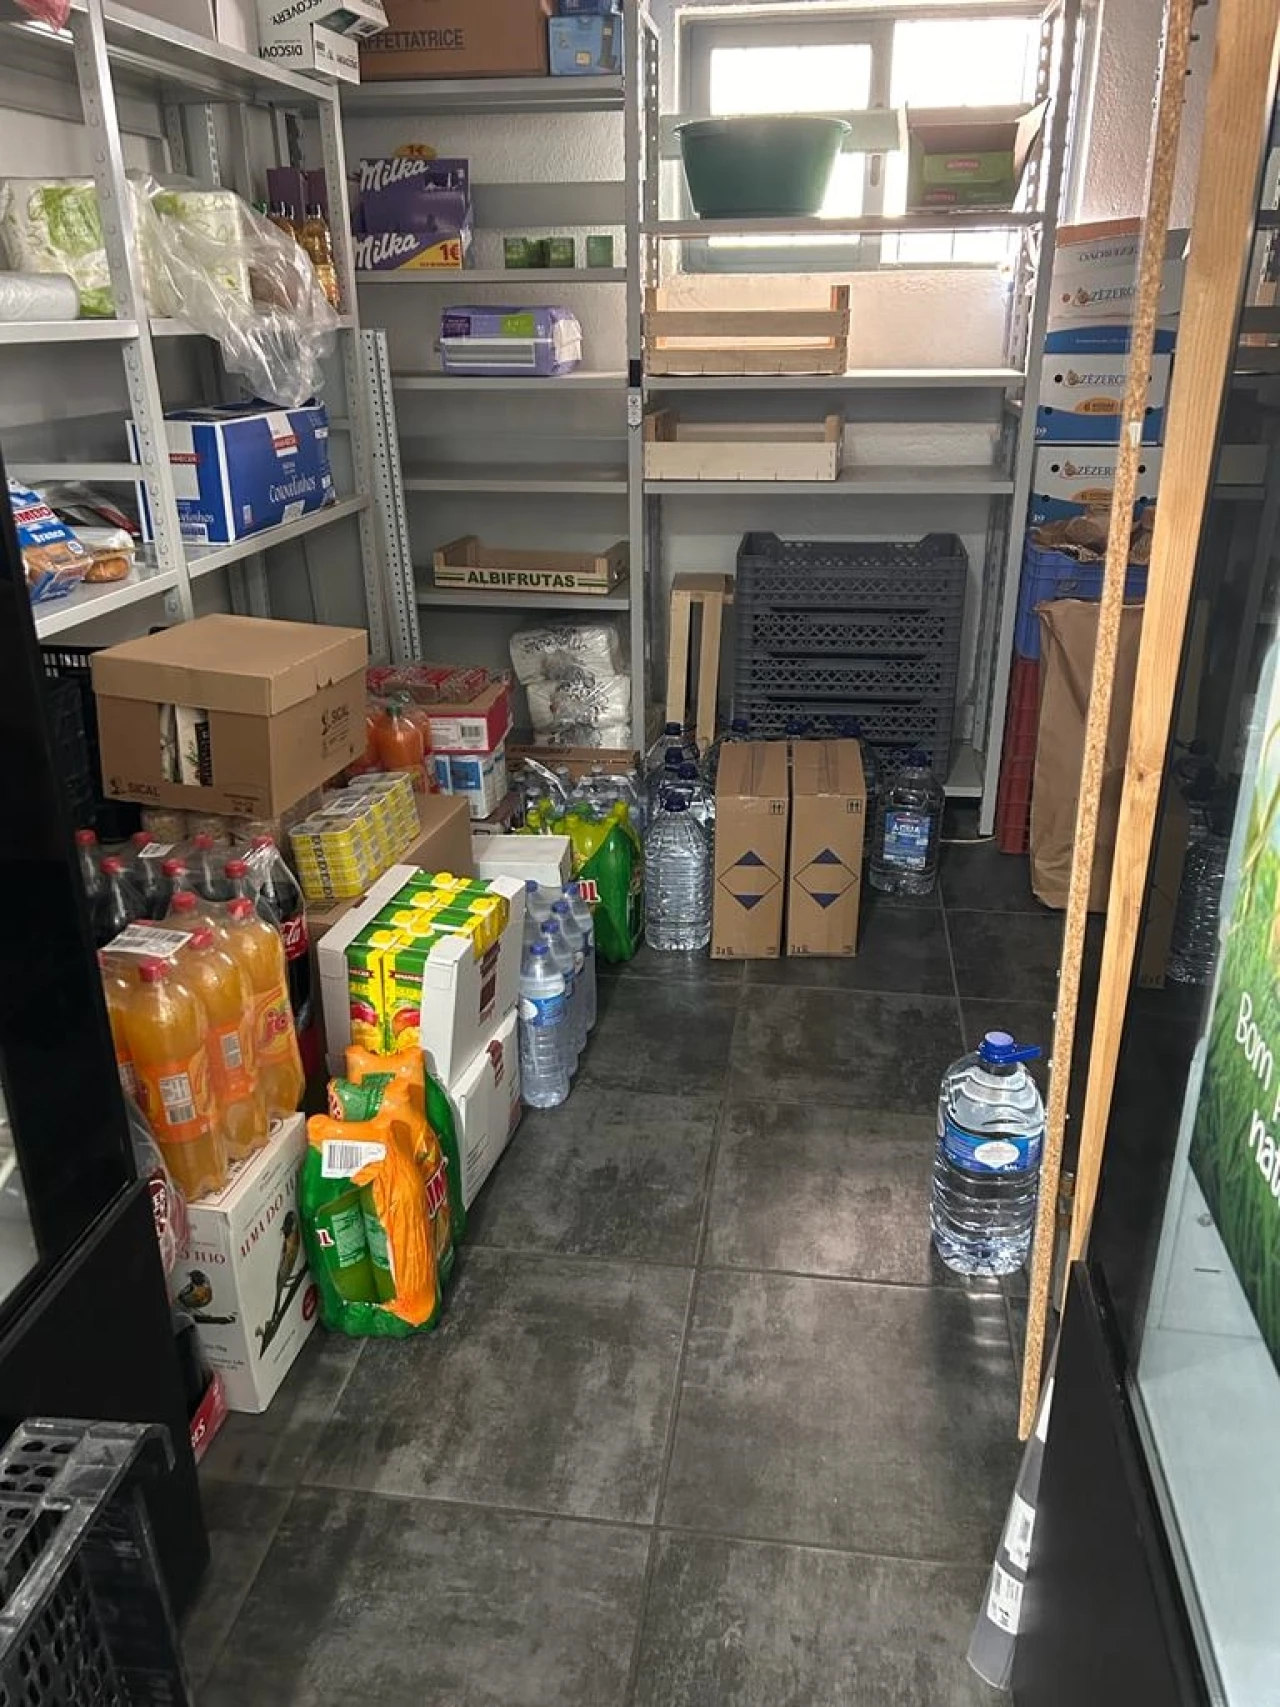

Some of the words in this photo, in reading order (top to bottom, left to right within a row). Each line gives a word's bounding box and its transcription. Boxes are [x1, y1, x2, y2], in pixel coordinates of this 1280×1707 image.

[360, 158, 429, 192] Milka
[351, 233, 420, 270] Milka
[440, 244, 460, 261] 1€
[16, 507, 52, 523] IMBO
[467, 571, 576, 588] ALBIFRUTAS
[1235, 991, 1274, 1092] Bom
